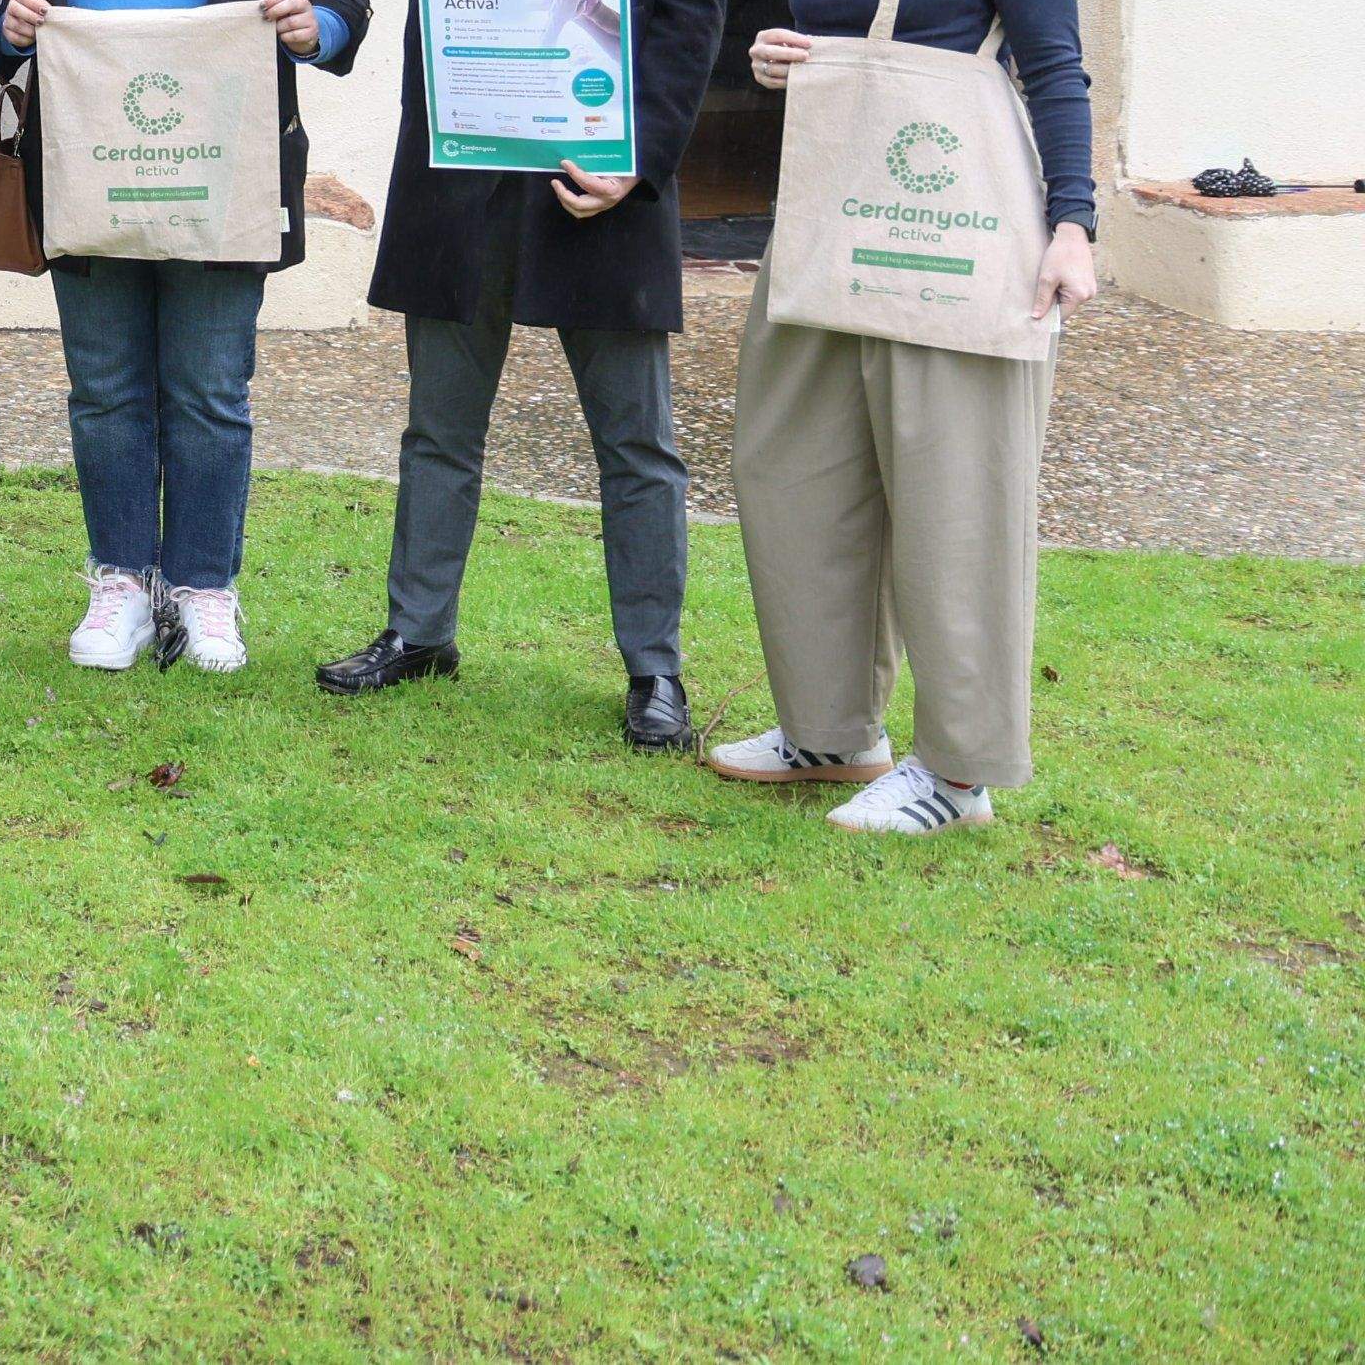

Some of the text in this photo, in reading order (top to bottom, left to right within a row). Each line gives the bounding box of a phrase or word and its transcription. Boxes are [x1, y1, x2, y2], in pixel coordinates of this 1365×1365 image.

[92, 143, 221, 164] Cerdanyola
[135, 166, 179, 176] Activa
[841, 198, 999, 232] Cerdanyola
[888, 226, 941, 243] Activa
